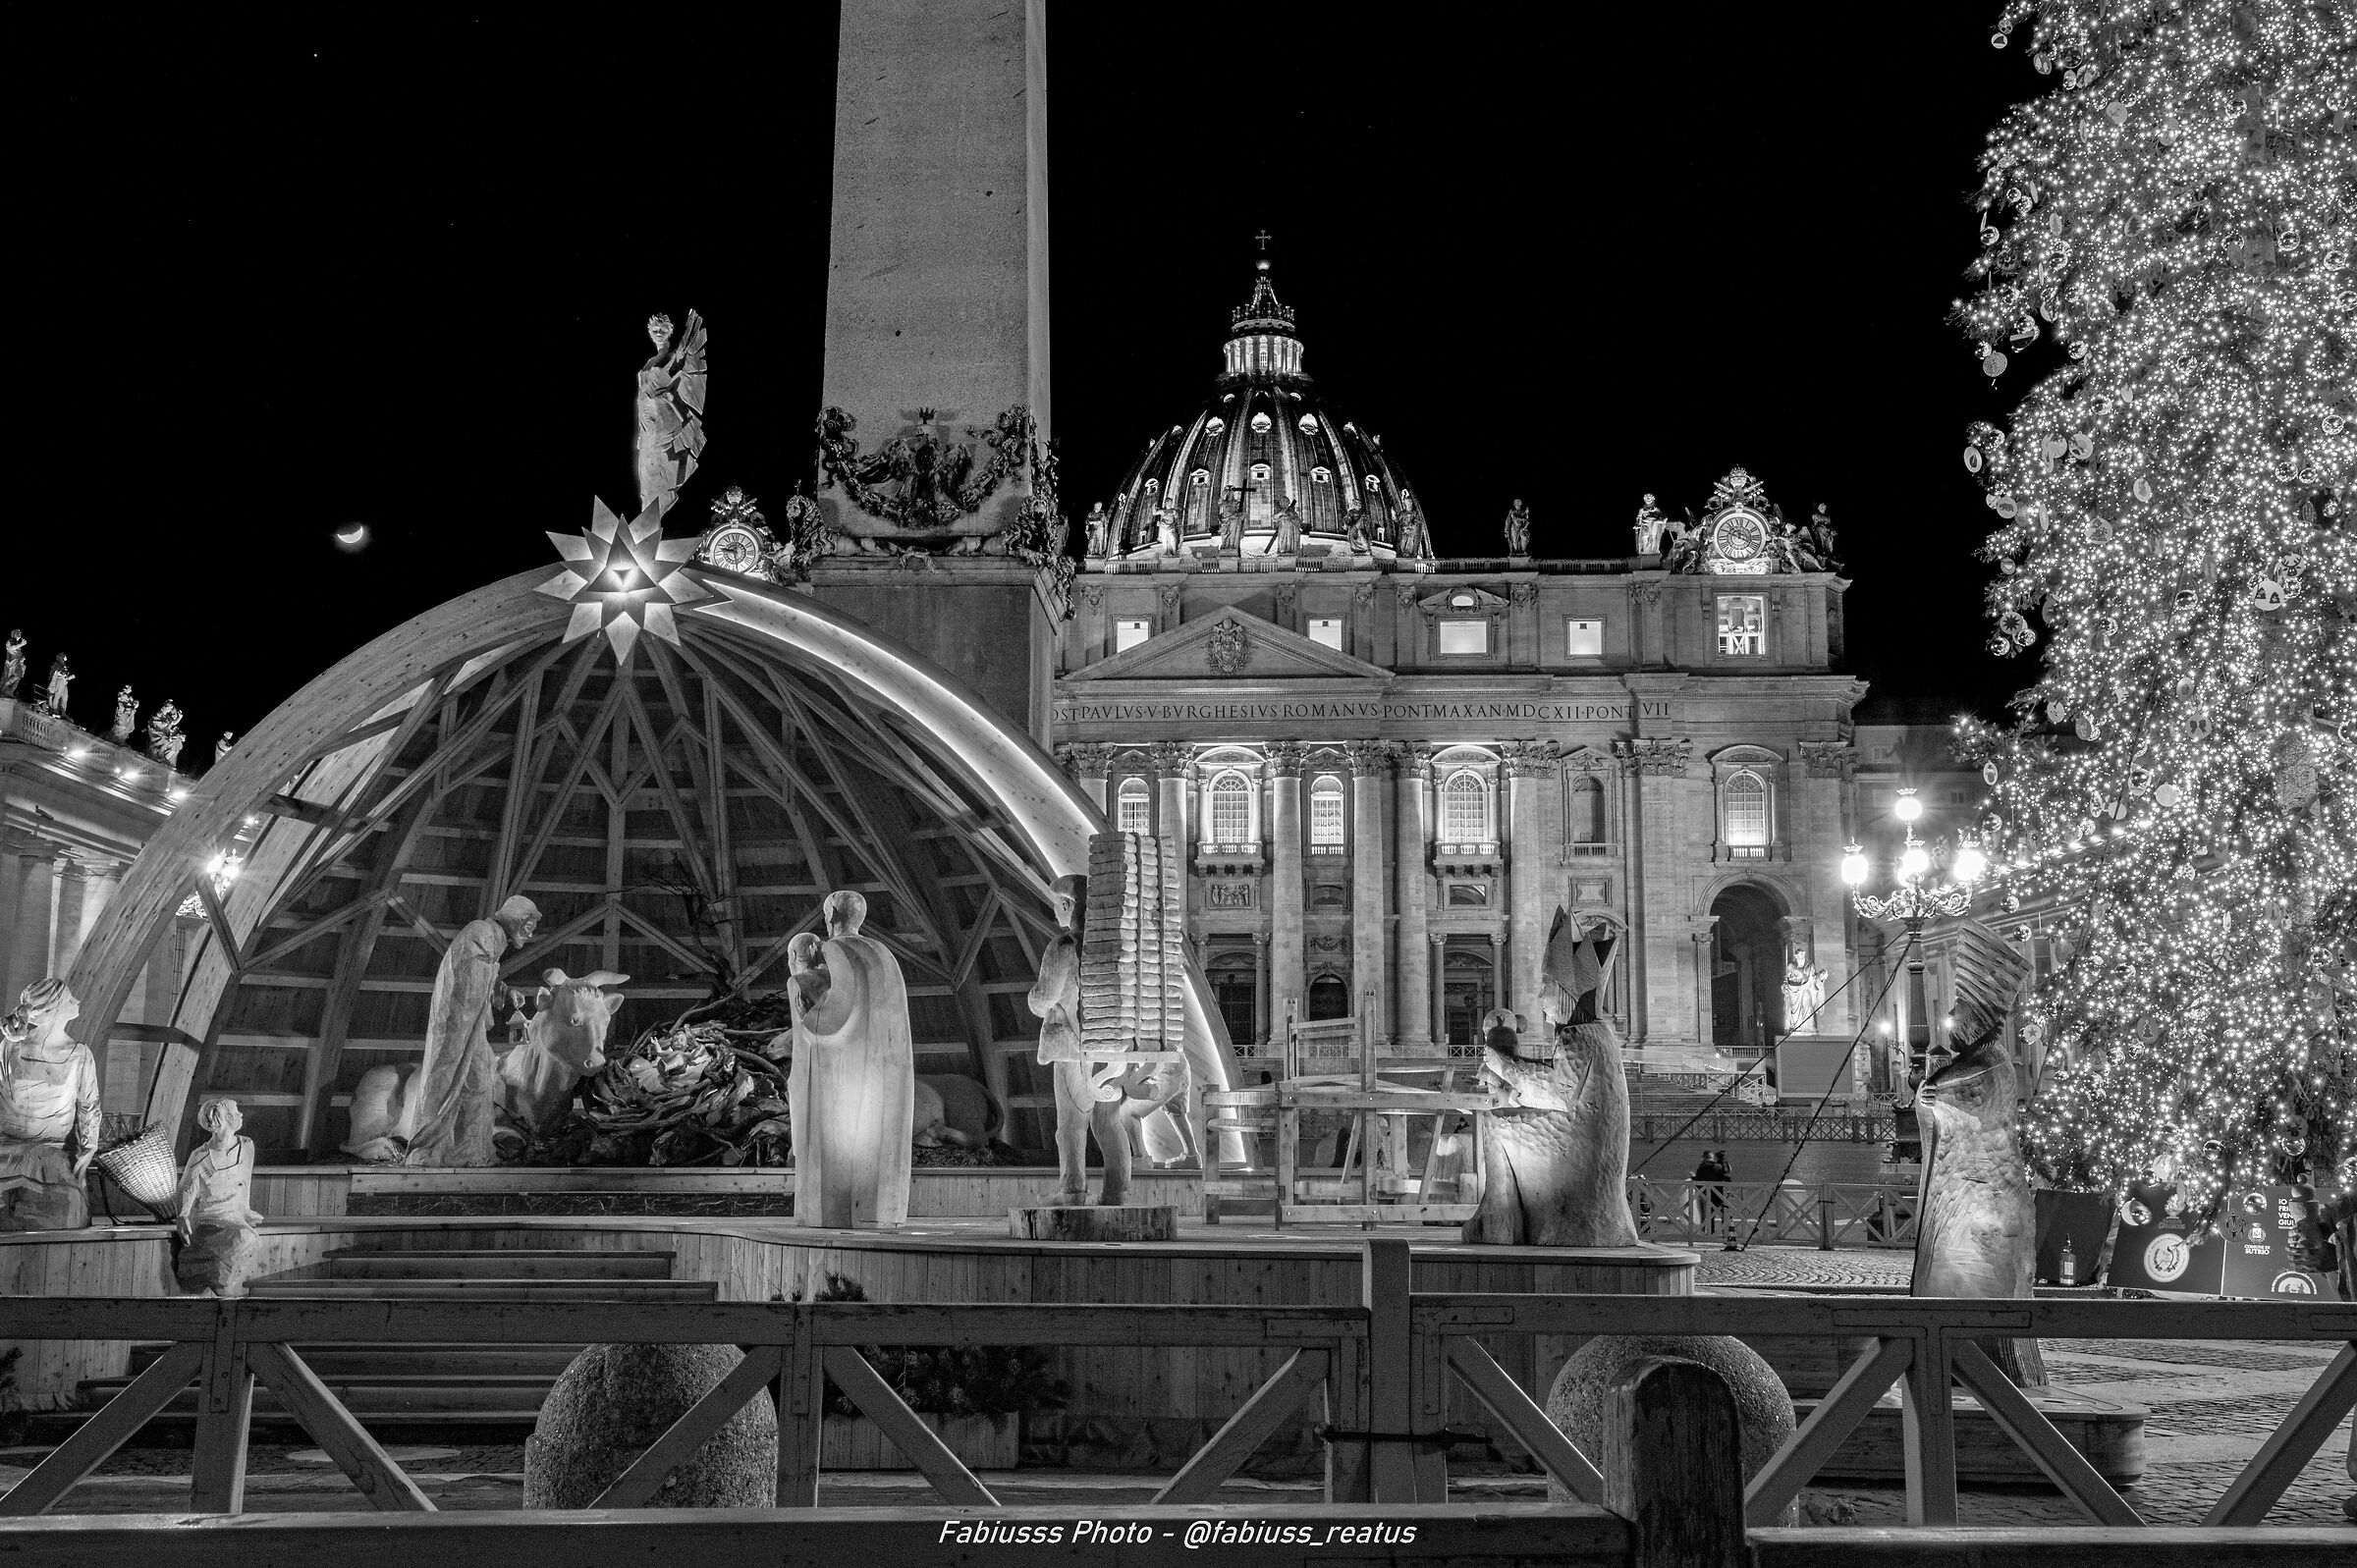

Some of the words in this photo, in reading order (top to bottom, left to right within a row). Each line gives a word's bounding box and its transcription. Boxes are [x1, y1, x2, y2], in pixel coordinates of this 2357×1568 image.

[1081, 705, 1143, 720] PAVLVS
[1162, 704, 1278, 719] BVRGHESIVS
[1283, 703, 1378, 718] ROMANVS
[1383, 704, 1431, 719] PONT
[1433, 704, 1473, 719] MAX
[1641, 702, 1670, 716] VII
